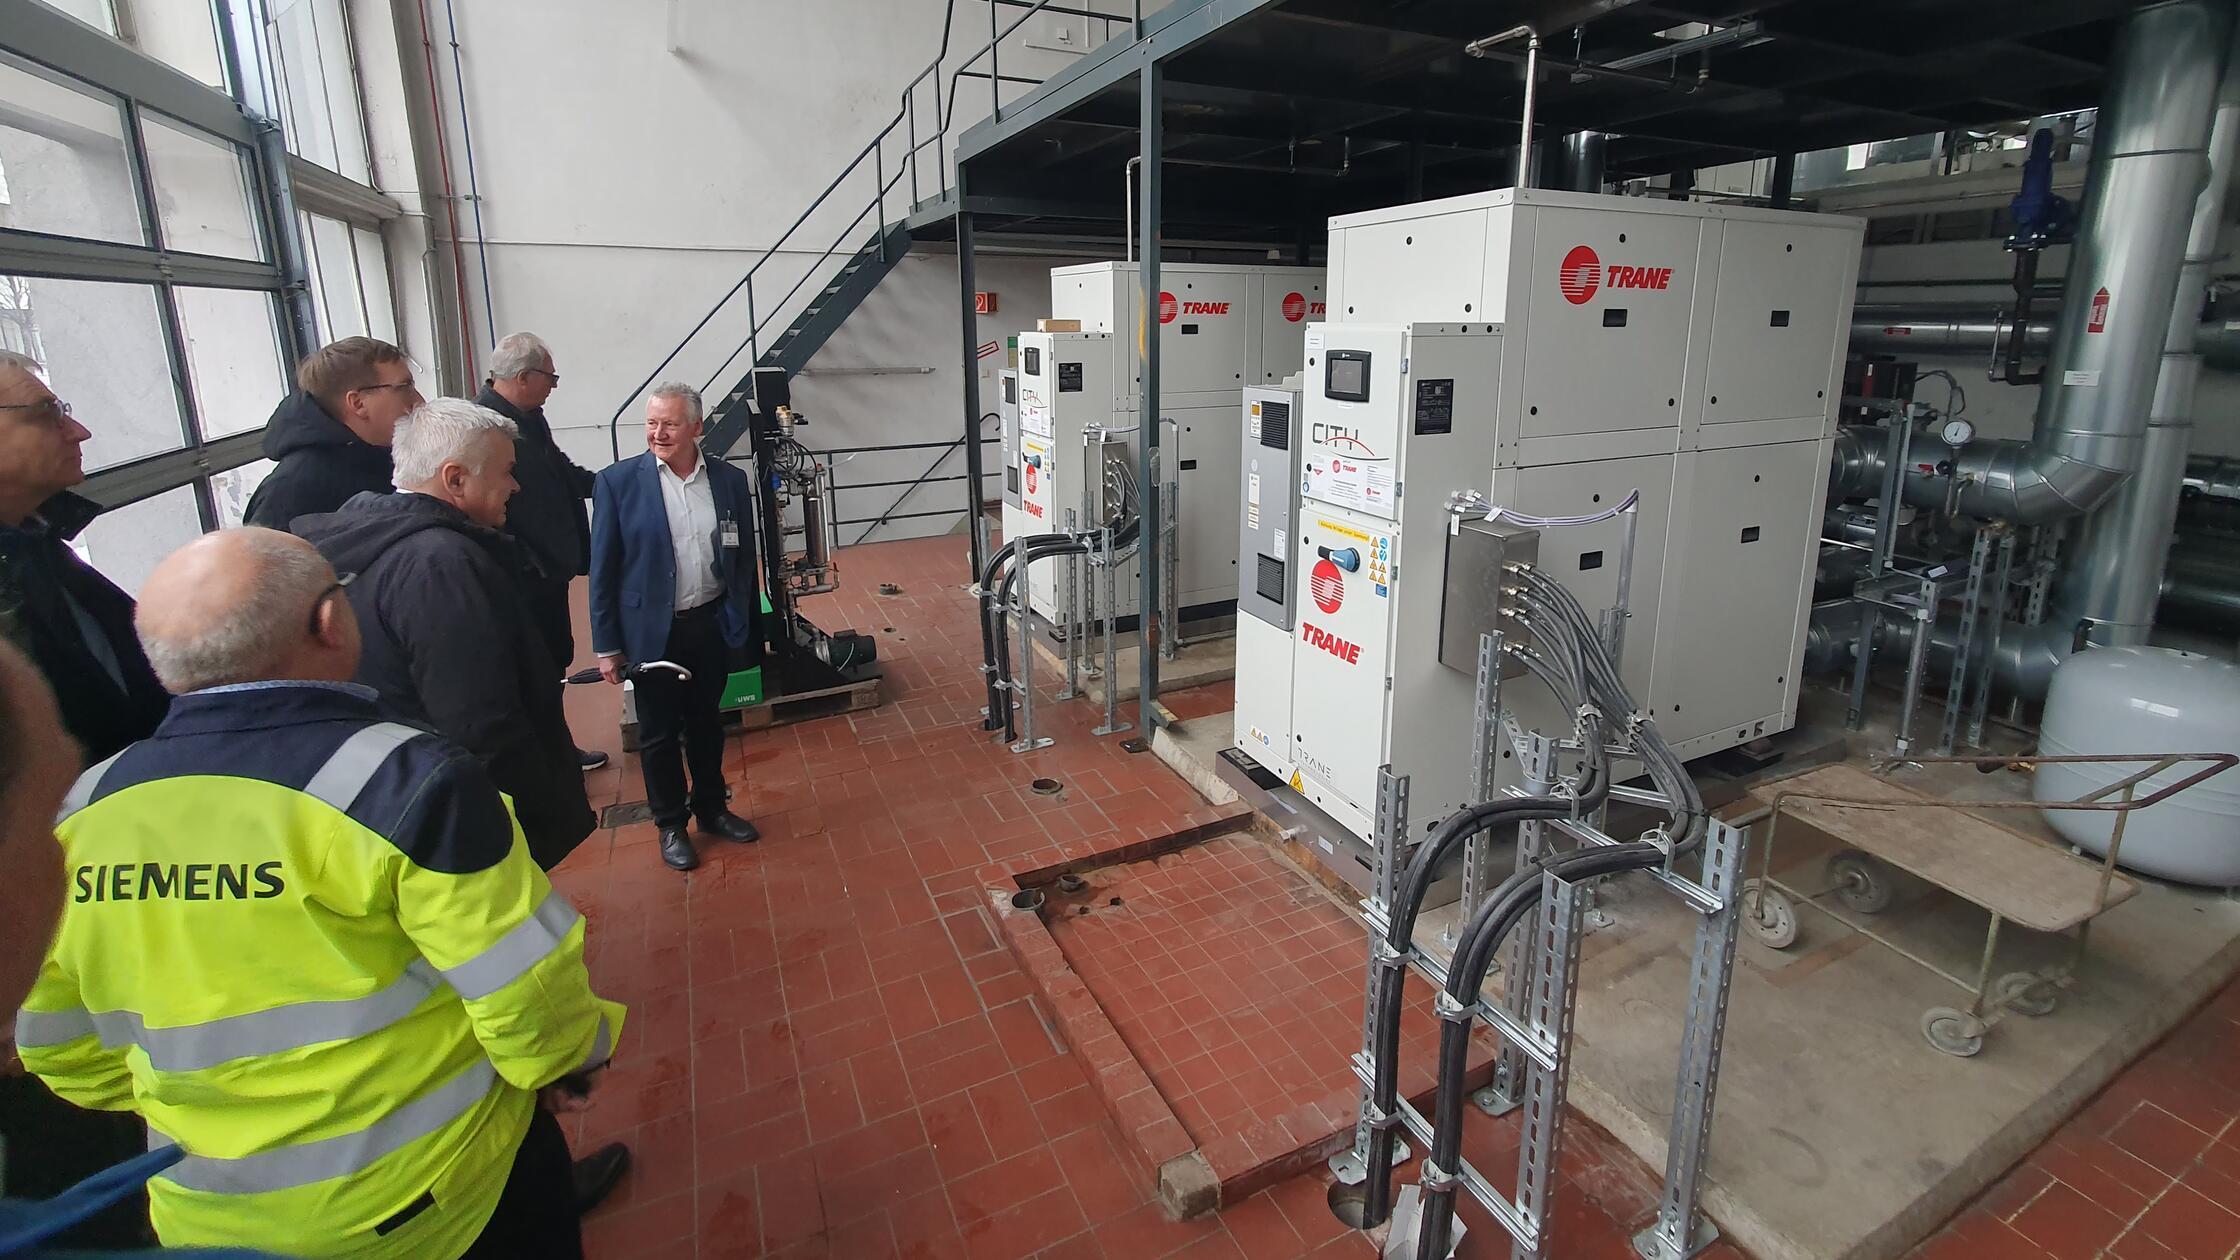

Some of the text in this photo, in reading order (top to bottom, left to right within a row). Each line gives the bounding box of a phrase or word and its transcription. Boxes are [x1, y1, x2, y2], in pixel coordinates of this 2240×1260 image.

[1607, 266, 1673, 289] TRANE
[1183, 303, 1230, 314] TRANE
[1310, 303, 1326, 313] TR
[1023, 500, 1043, 518] TRANE
[1303, 622, 1360, 665] TRANE
[75, 861, 285, 903] SIEMENS
